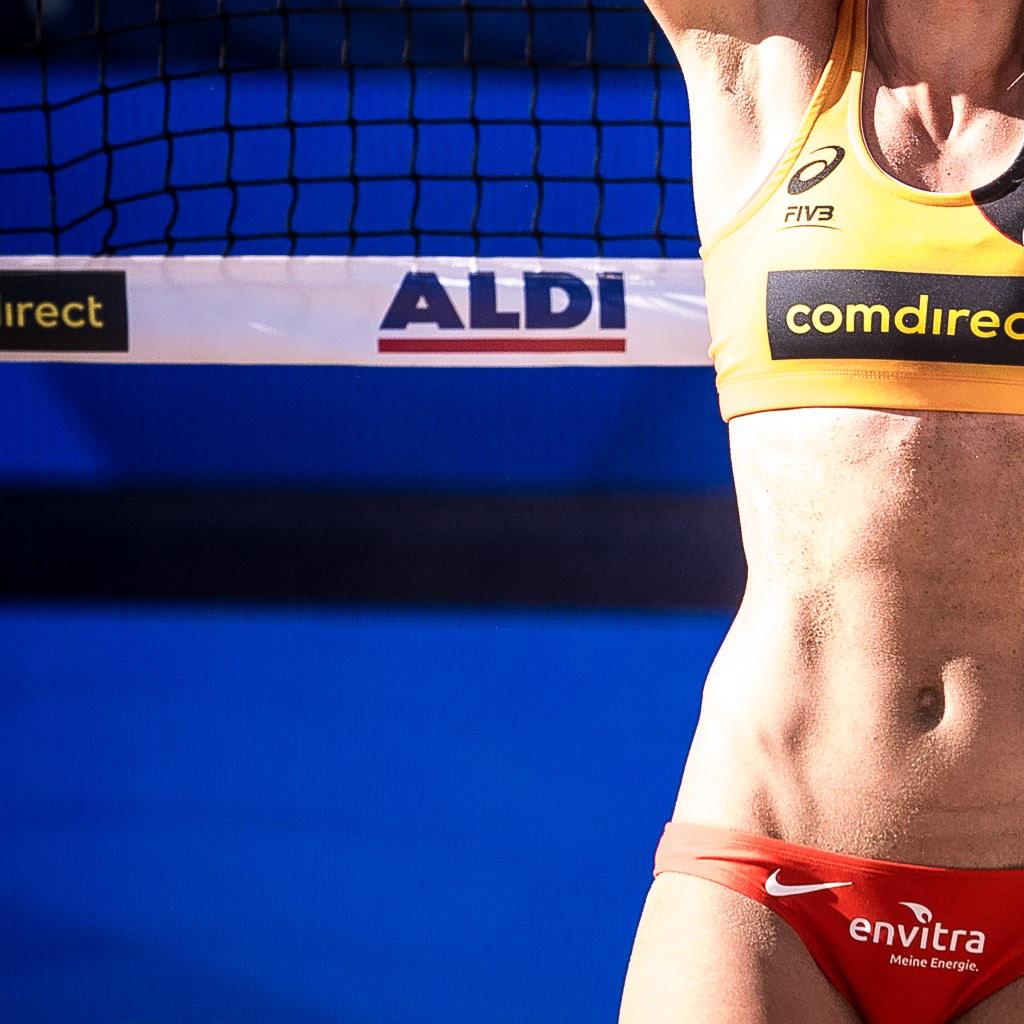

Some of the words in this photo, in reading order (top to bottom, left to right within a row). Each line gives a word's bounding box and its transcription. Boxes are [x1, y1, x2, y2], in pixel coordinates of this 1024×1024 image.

[784, 205, 835, 222] FIVB
[0, 294, 104, 329] irect
[380, 272, 626, 330] ALDI
[849, 908, 986, 954] envitra
[889, 953, 927, 968] Meine
[930, 957, 980, 972] Energie.
